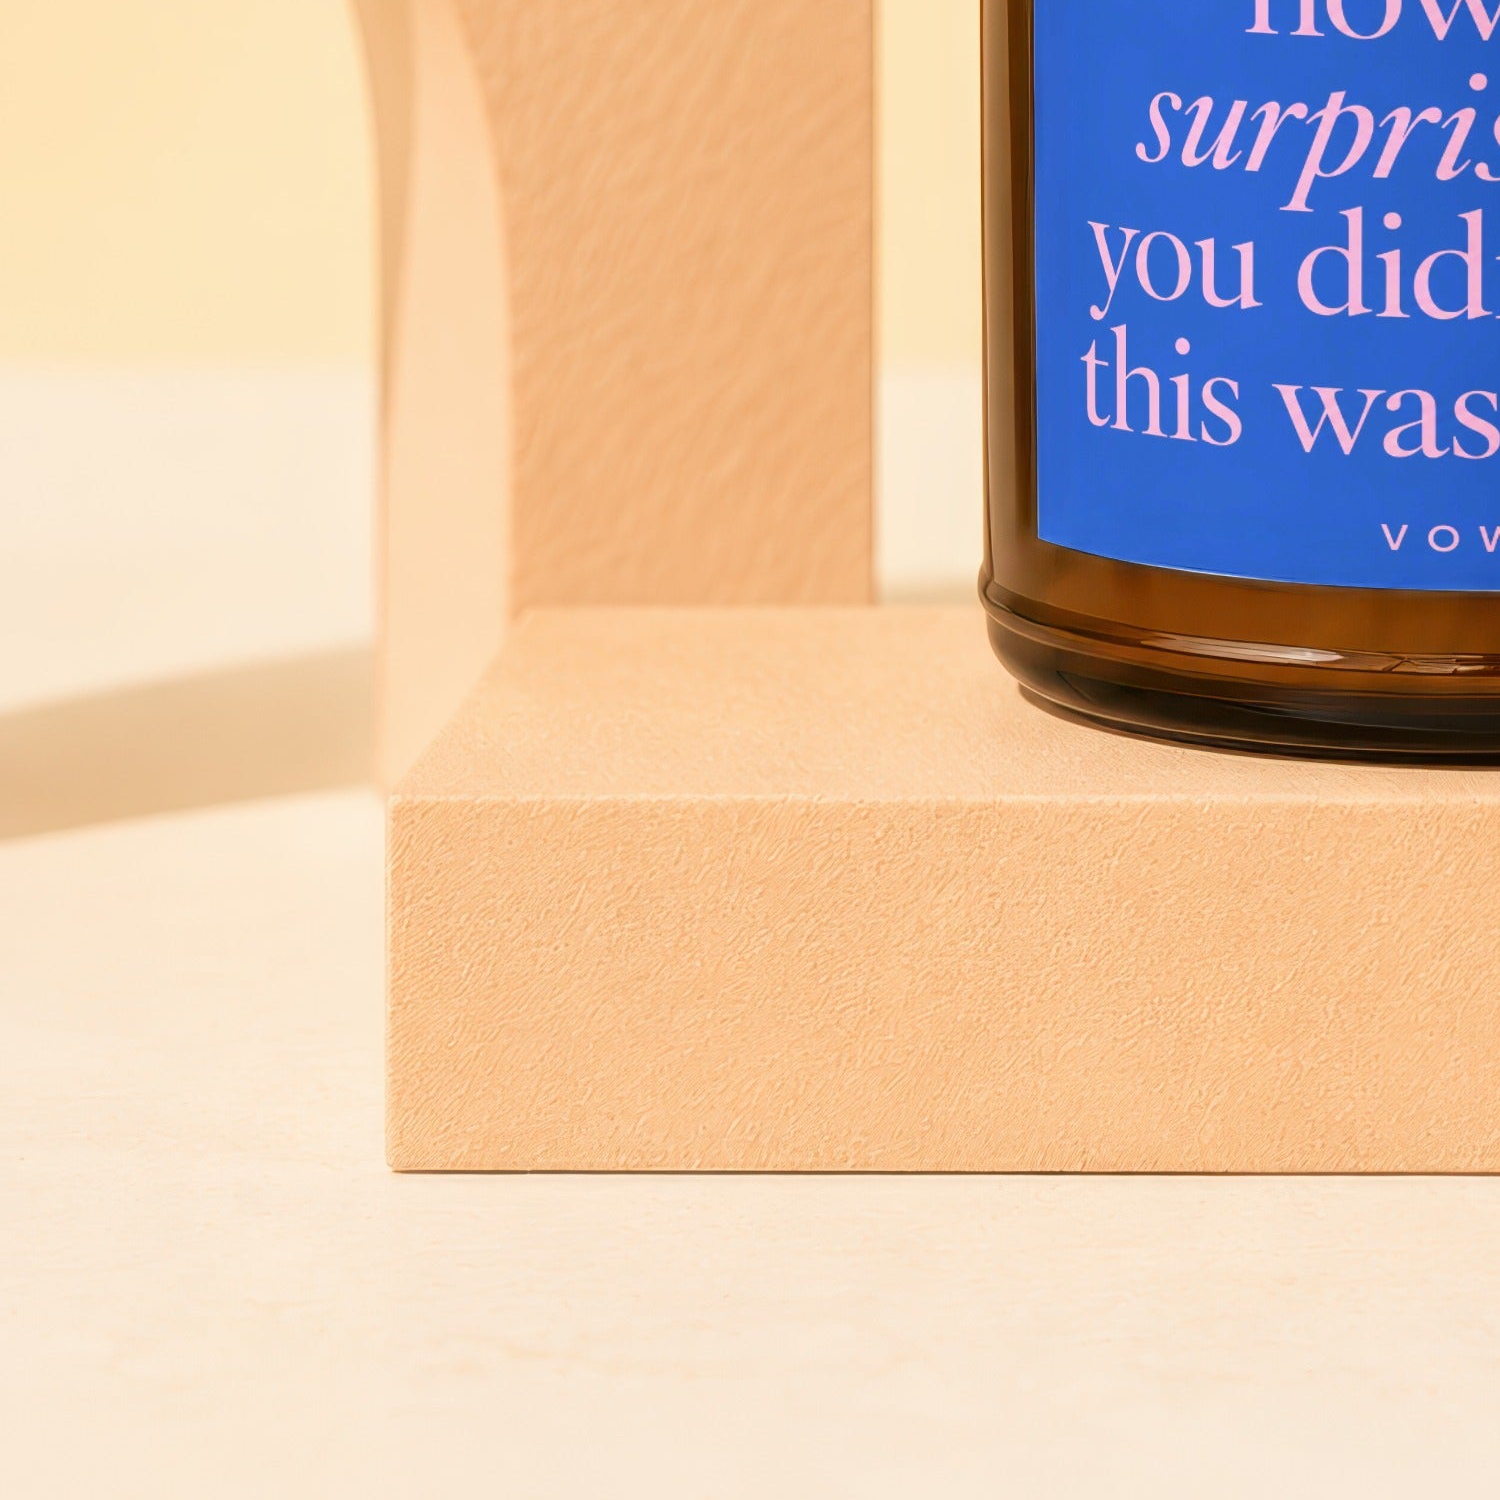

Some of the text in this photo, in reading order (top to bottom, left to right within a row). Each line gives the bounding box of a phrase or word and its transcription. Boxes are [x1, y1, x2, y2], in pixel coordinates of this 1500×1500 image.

[1087, 220, 1263, 321] you
[1080, 323, 1243, 446] this
[1271, 383, 1500, 460] was
